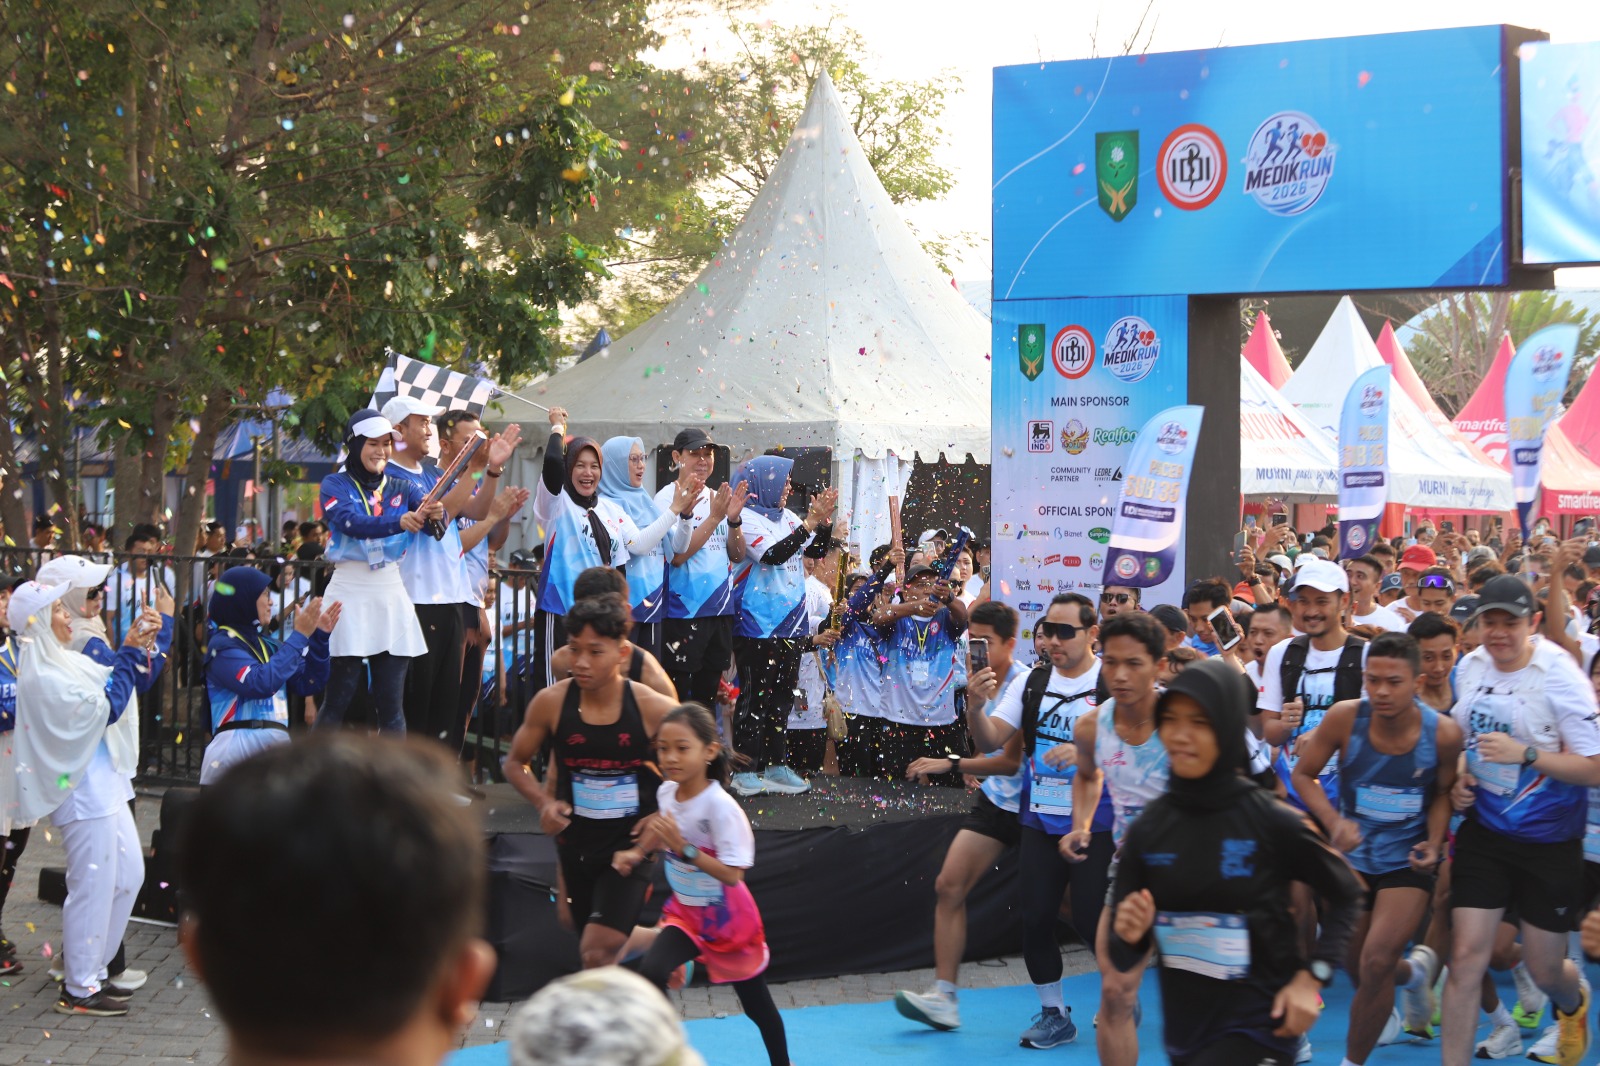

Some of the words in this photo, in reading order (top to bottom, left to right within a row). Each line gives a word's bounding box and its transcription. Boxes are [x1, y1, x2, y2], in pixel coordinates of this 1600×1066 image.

[1245, 155, 1333, 191] MEDIKRUN
[1103, 346, 1159, 366] MEDIKRUN
[1120, 361, 1142, 373] 2026
[1051, 397, 1078, 407] MAIN
[1080, 396, 1130, 407] SPONSOR
[1031, 443, 1051, 451] INDO
[1050, 466, 1091, 474] COMMUNITY
[1149, 459, 1184, 479] PACER
[1256, 467, 1292, 481] MURNI
[1124, 475, 1156, 498] SUB
[1158, 481, 1181, 503] 35
[1418, 479, 1449, 496] MURNI
[1038, 505, 1082, 517] OFFICIAL
[1064, 530, 1083, 538] Biznet
[1037, 584, 1054, 594] Tango
[1033, 787, 1050, 797] SUB
